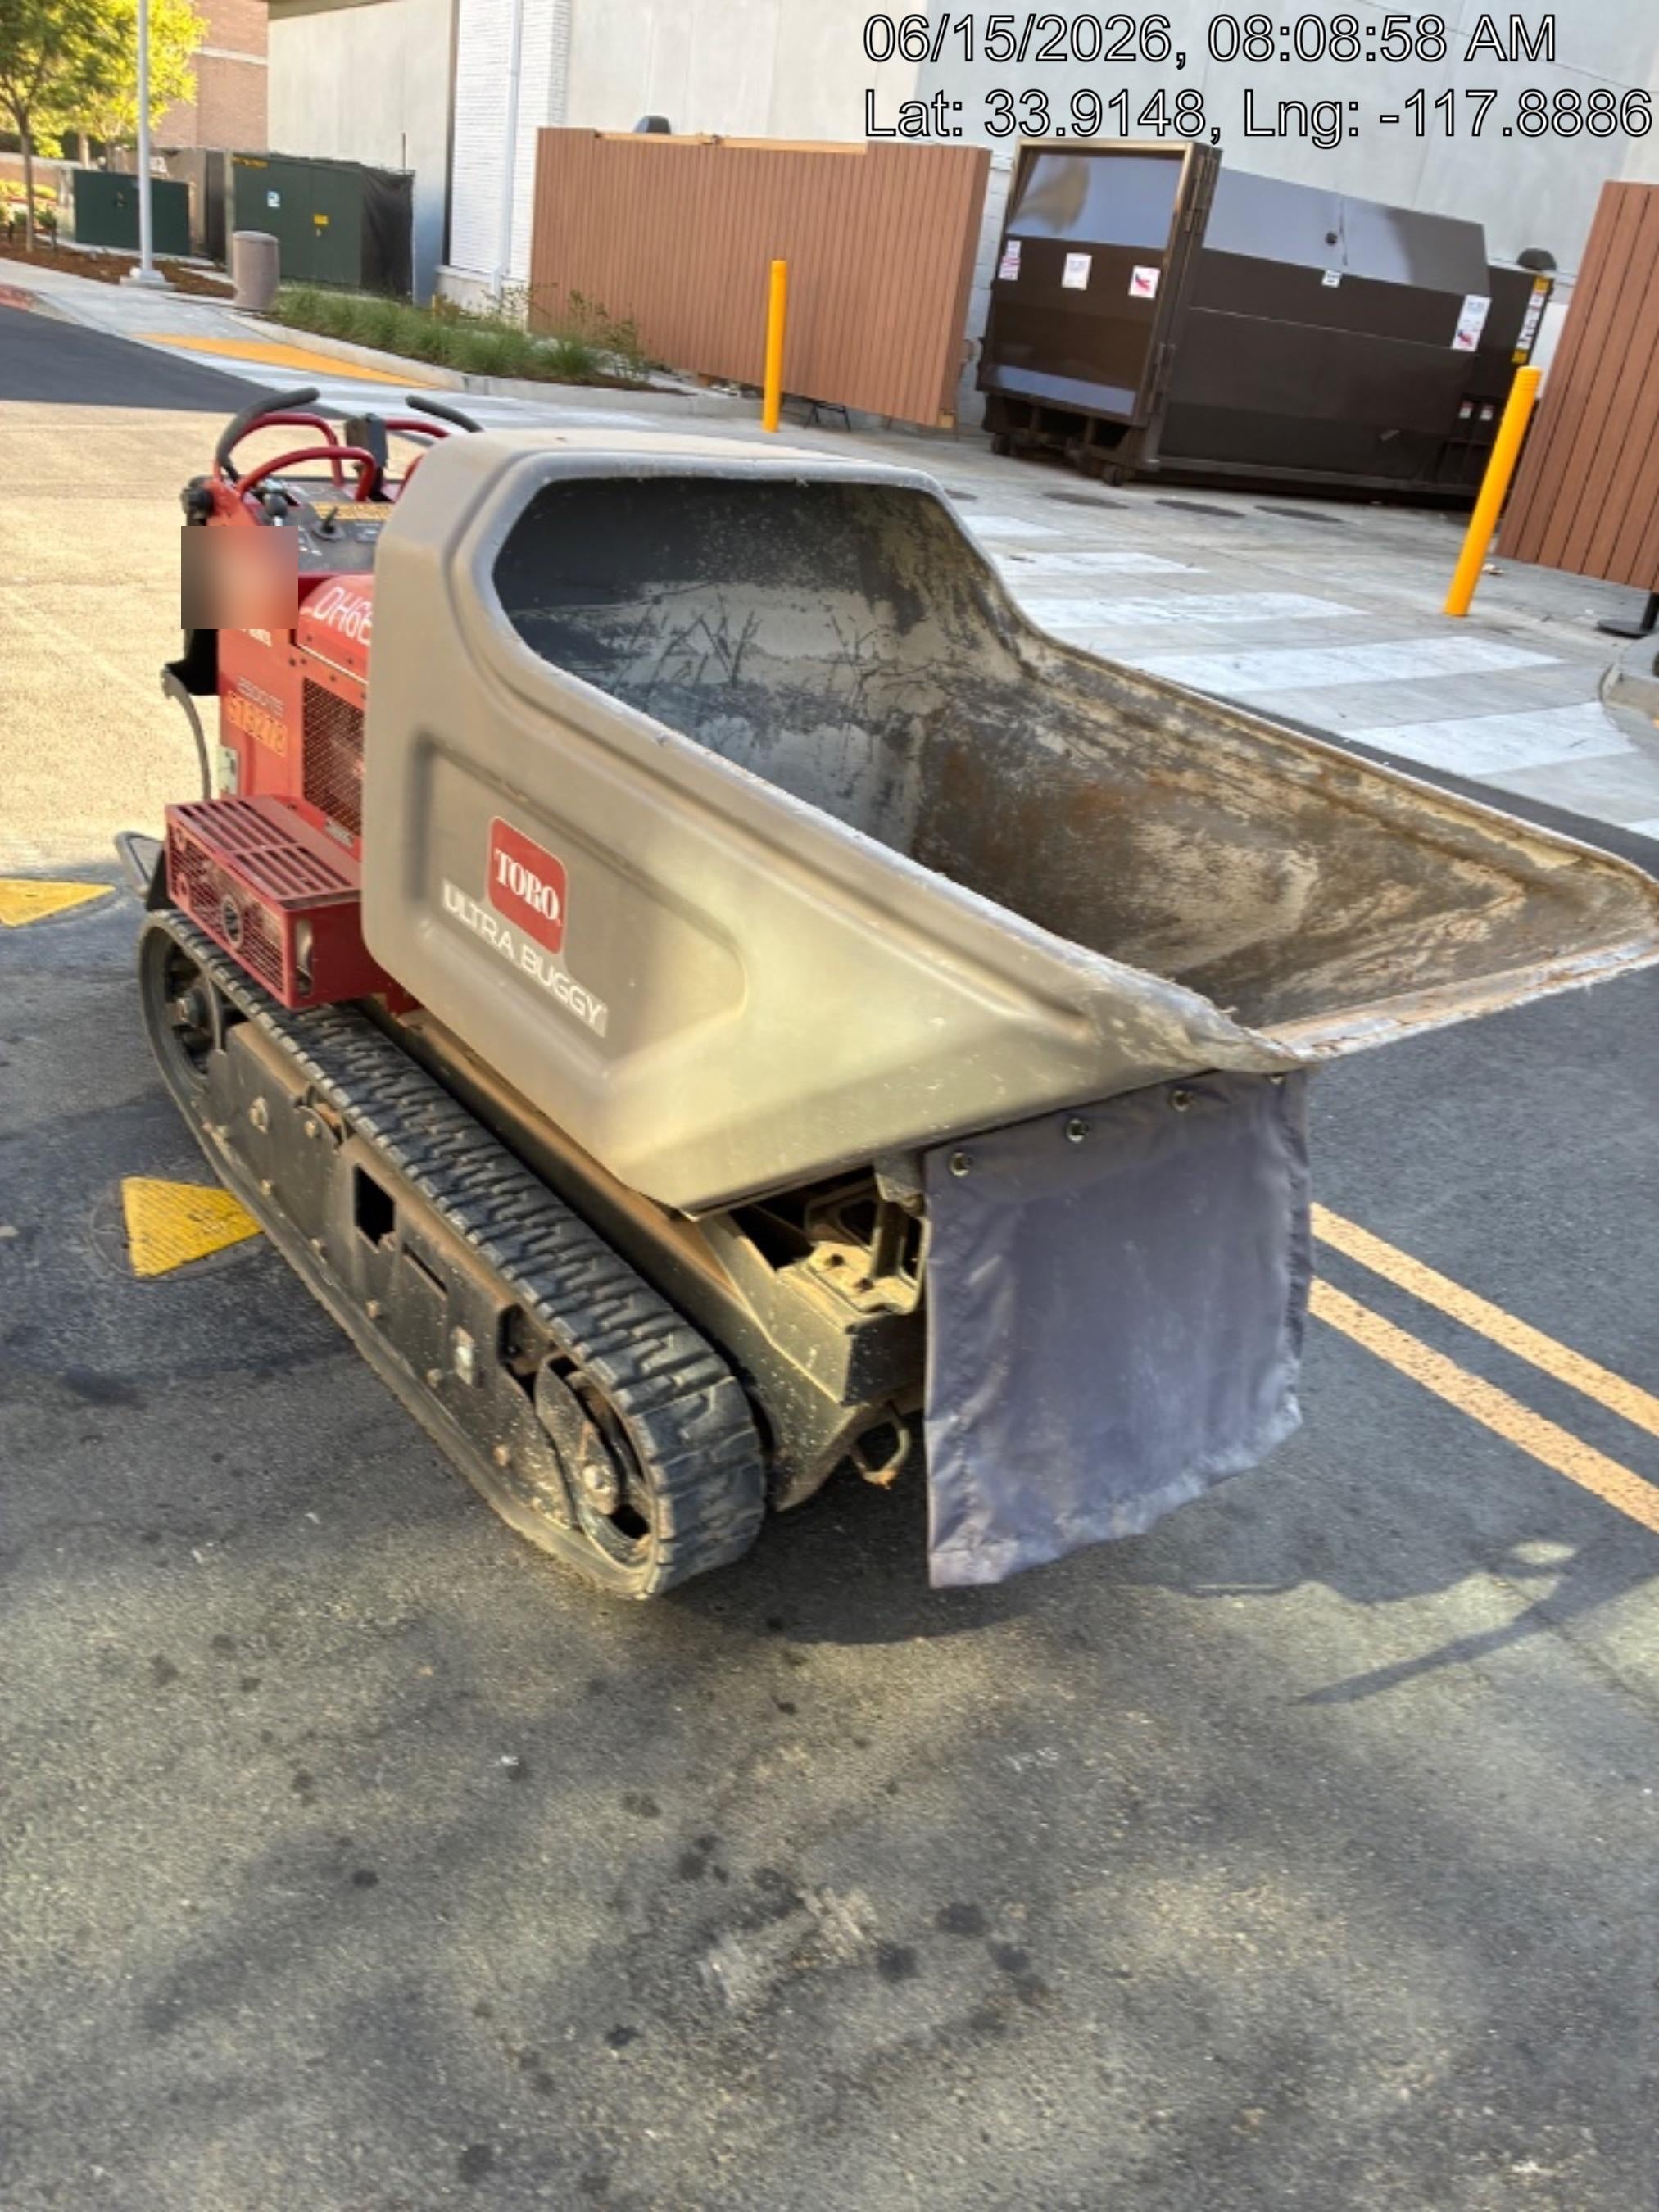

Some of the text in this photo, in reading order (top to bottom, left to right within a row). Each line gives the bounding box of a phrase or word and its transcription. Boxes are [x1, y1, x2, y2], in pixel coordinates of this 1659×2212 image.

[493, 847, 560, 921] TORO
[442, 881, 604, 1024] ULTRA BUGGY
